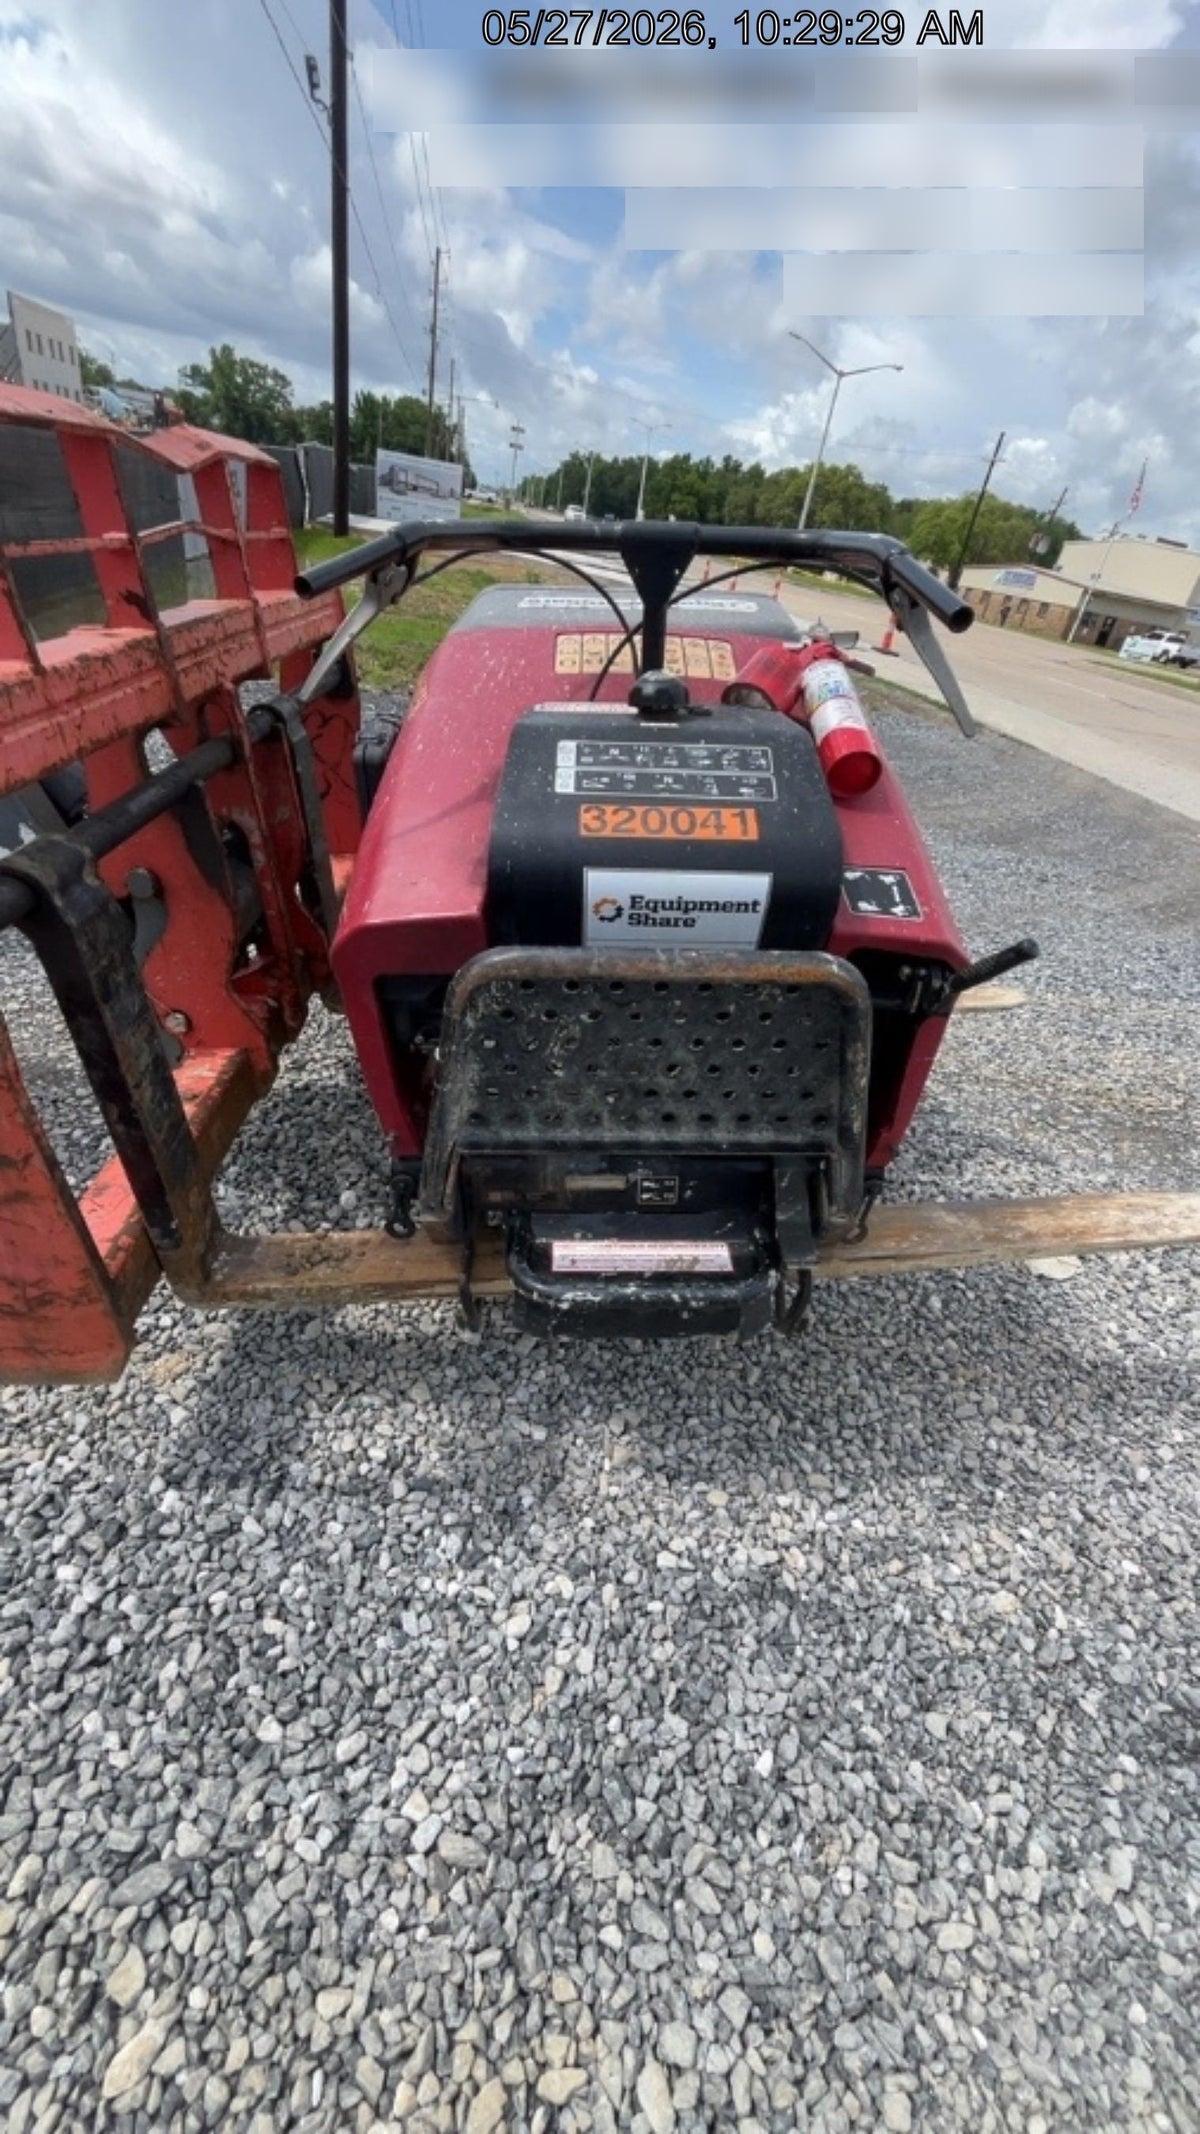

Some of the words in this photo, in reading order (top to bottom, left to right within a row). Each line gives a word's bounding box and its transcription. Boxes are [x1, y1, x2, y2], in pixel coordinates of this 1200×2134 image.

[582, 806, 751, 836] 320041
[629, 895, 761, 914] Equipment
[628, 913, 696, 928] Share
